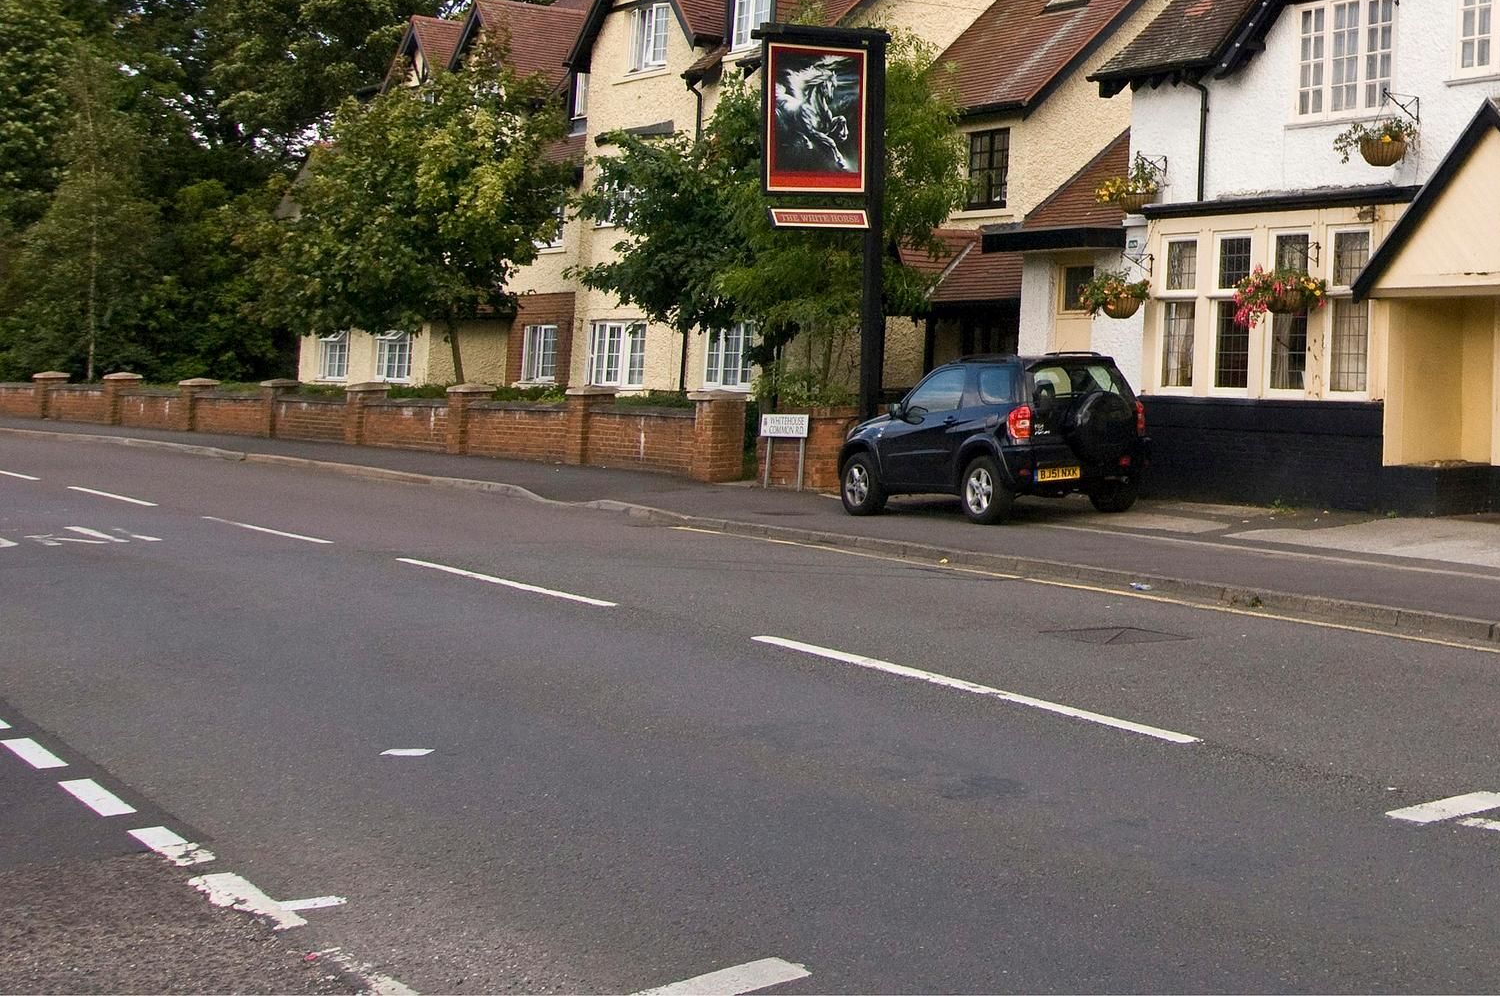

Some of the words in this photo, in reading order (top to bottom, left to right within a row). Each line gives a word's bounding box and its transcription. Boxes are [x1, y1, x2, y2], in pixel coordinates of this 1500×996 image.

[782, 213, 800, 221] THE
[801, 214, 829, 222] WHITE
[830, 214, 860, 223] HORSE
[769, 425, 794, 434] COMMON
